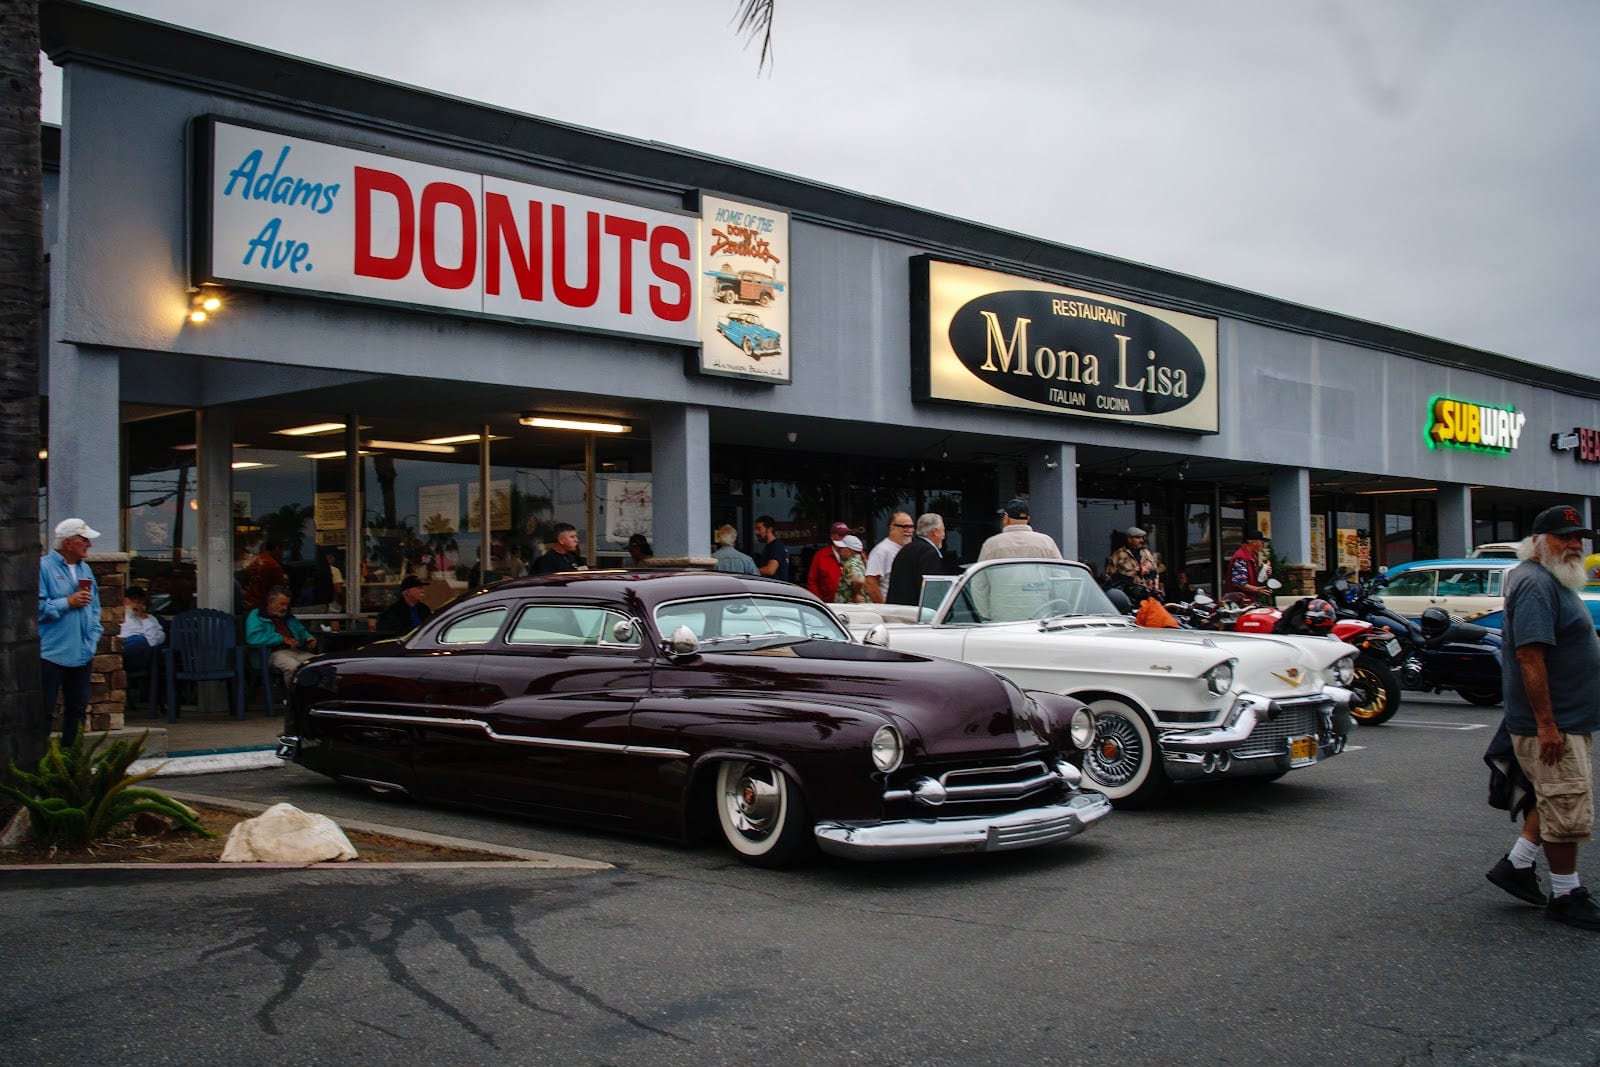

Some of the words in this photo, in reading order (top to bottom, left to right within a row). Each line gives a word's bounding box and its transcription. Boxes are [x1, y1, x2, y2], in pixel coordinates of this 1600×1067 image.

[224, 145, 340, 214] Adams
[242, 217, 313, 273] Ave.
[354, 165, 692, 322] DONUTS
[715, 207, 743, 225] HOME
[744, 214, 757, 228] OF
[757, 216, 775, 232] THE
[1052, 299, 1127, 328] RESTAURANT
[980, 310, 1100, 386] Mona
[1114, 334, 1189, 399] Lisa
[1049, 388, 1086, 407] ITALIAN
[1096, 394, 1130, 412] CUCINA
[1432, 400, 1527, 450] SUBWAY
